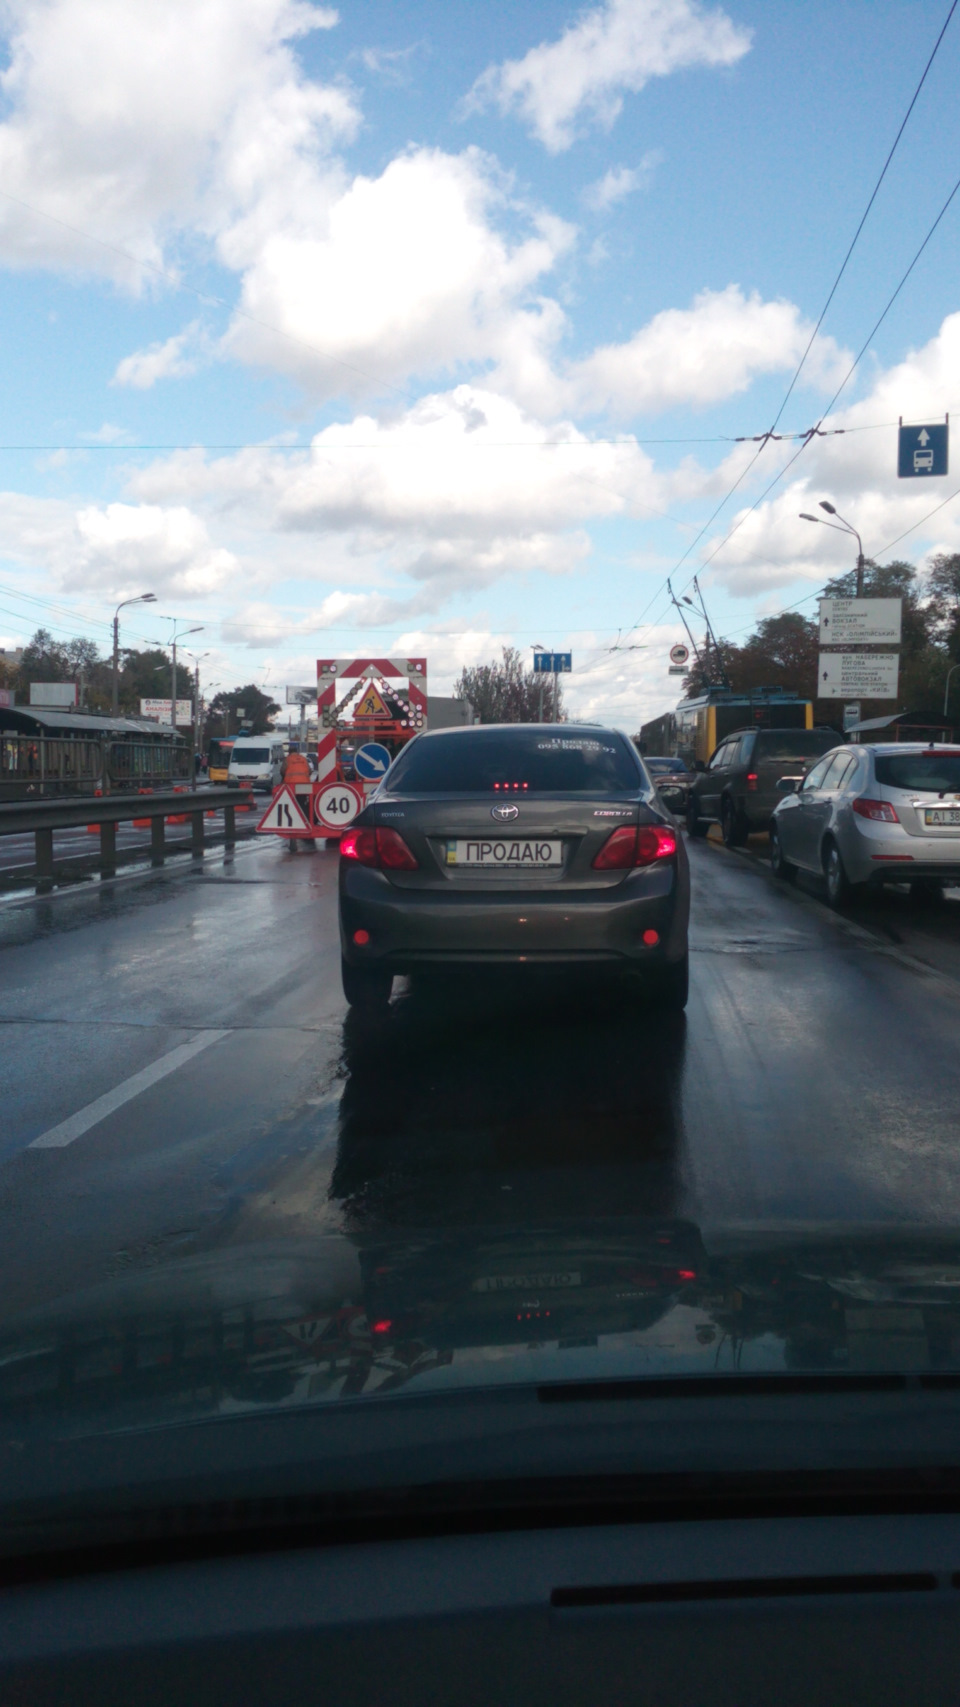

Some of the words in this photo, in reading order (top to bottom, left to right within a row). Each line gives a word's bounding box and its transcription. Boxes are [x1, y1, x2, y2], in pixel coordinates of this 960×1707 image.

[551, 738, 600, 746] Продаю
[602, 746, 617, 754] 92
[326, 797, 350, 814] 40
[466, 842, 552, 862] ПРОДАЮ
